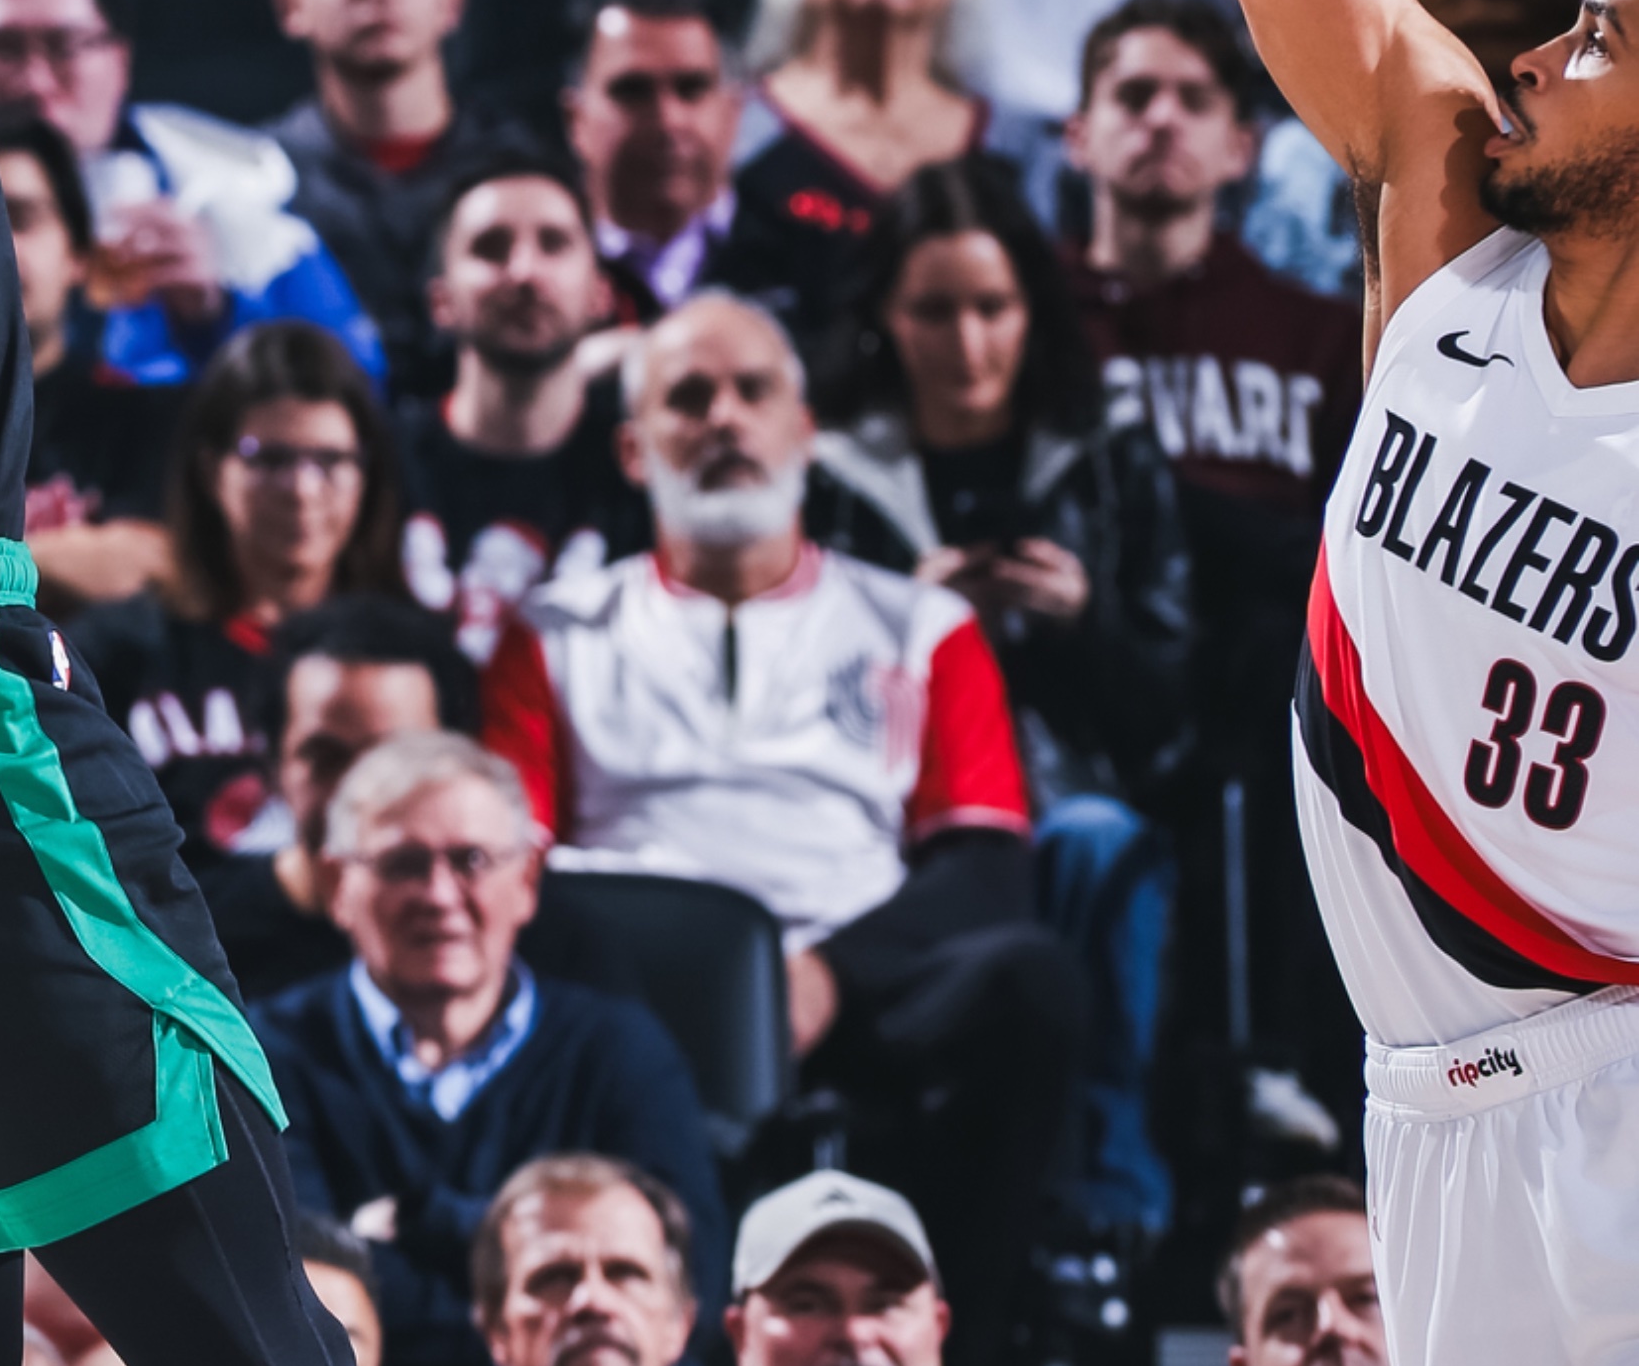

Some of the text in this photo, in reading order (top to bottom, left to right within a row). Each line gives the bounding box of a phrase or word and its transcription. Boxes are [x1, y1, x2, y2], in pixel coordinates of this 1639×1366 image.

[1355, 408, 1639, 662] BLAZERS
[1464, 657, 1607, 831] 33
[1447, 1046, 1523, 1088] ripcity
